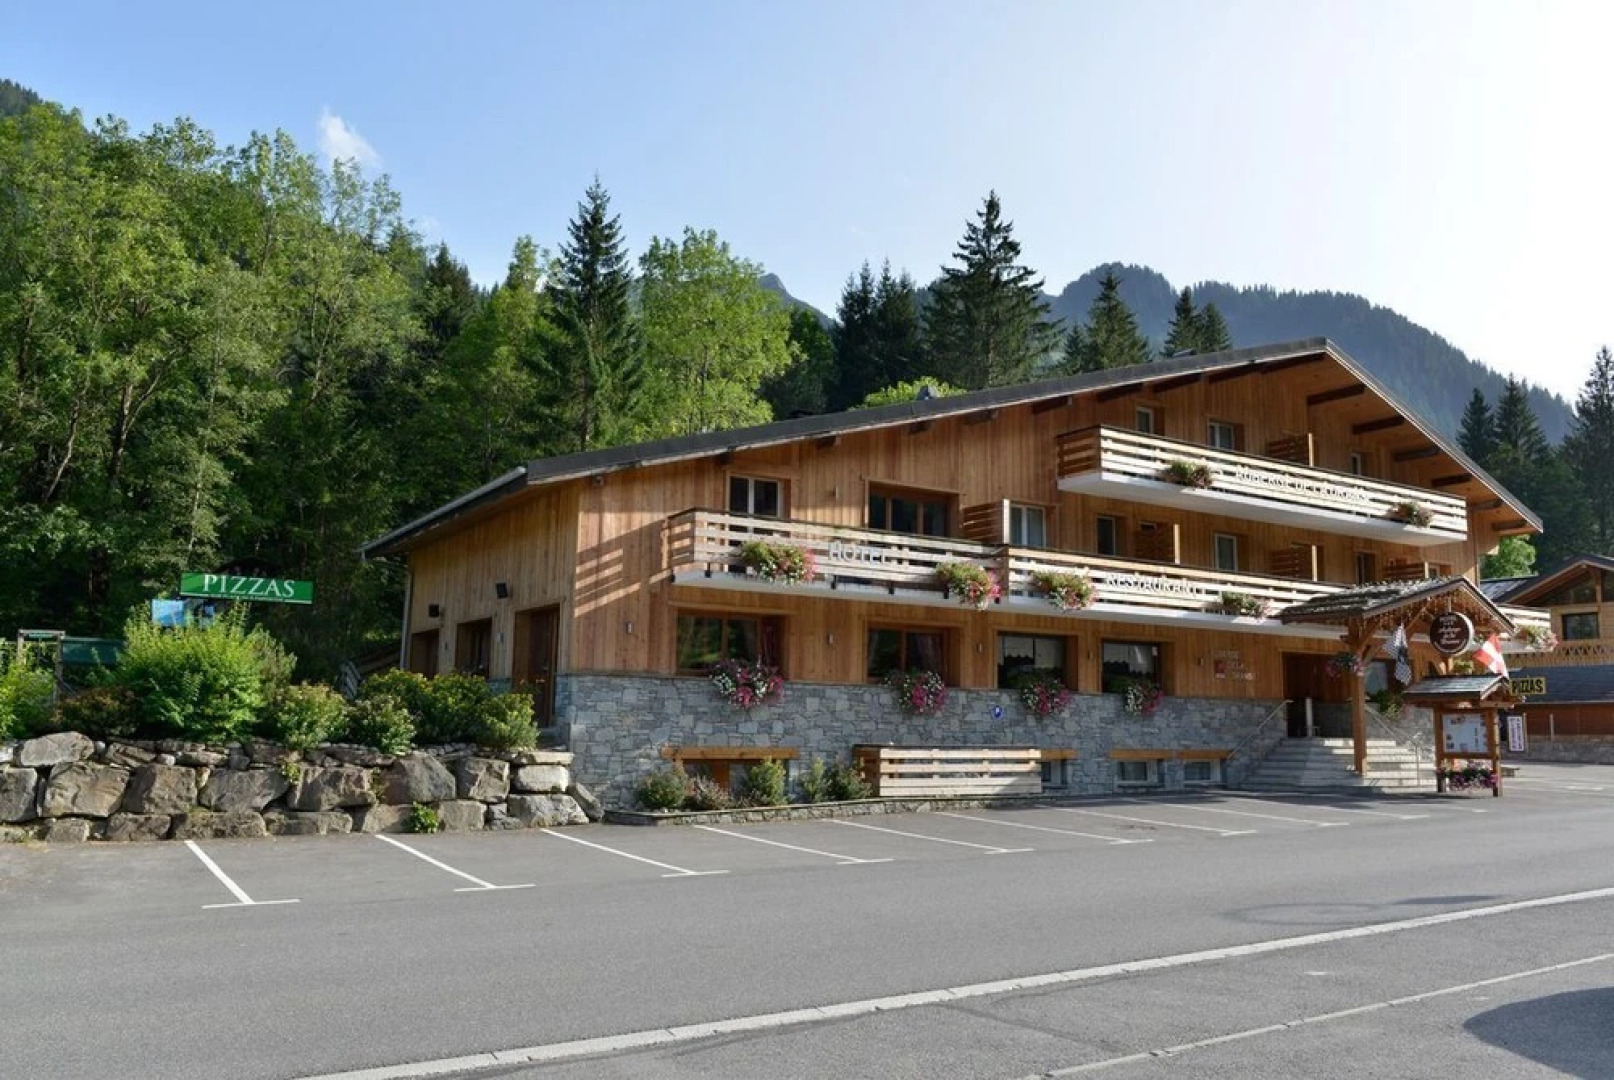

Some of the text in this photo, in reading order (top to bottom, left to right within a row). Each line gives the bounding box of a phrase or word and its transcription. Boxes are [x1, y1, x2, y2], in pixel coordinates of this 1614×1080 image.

[203, 574, 295, 598] PIZZAS
[1106, 573, 1199, 596] RESTAURANT
[1512, 679, 1543, 694] PIZZAS
